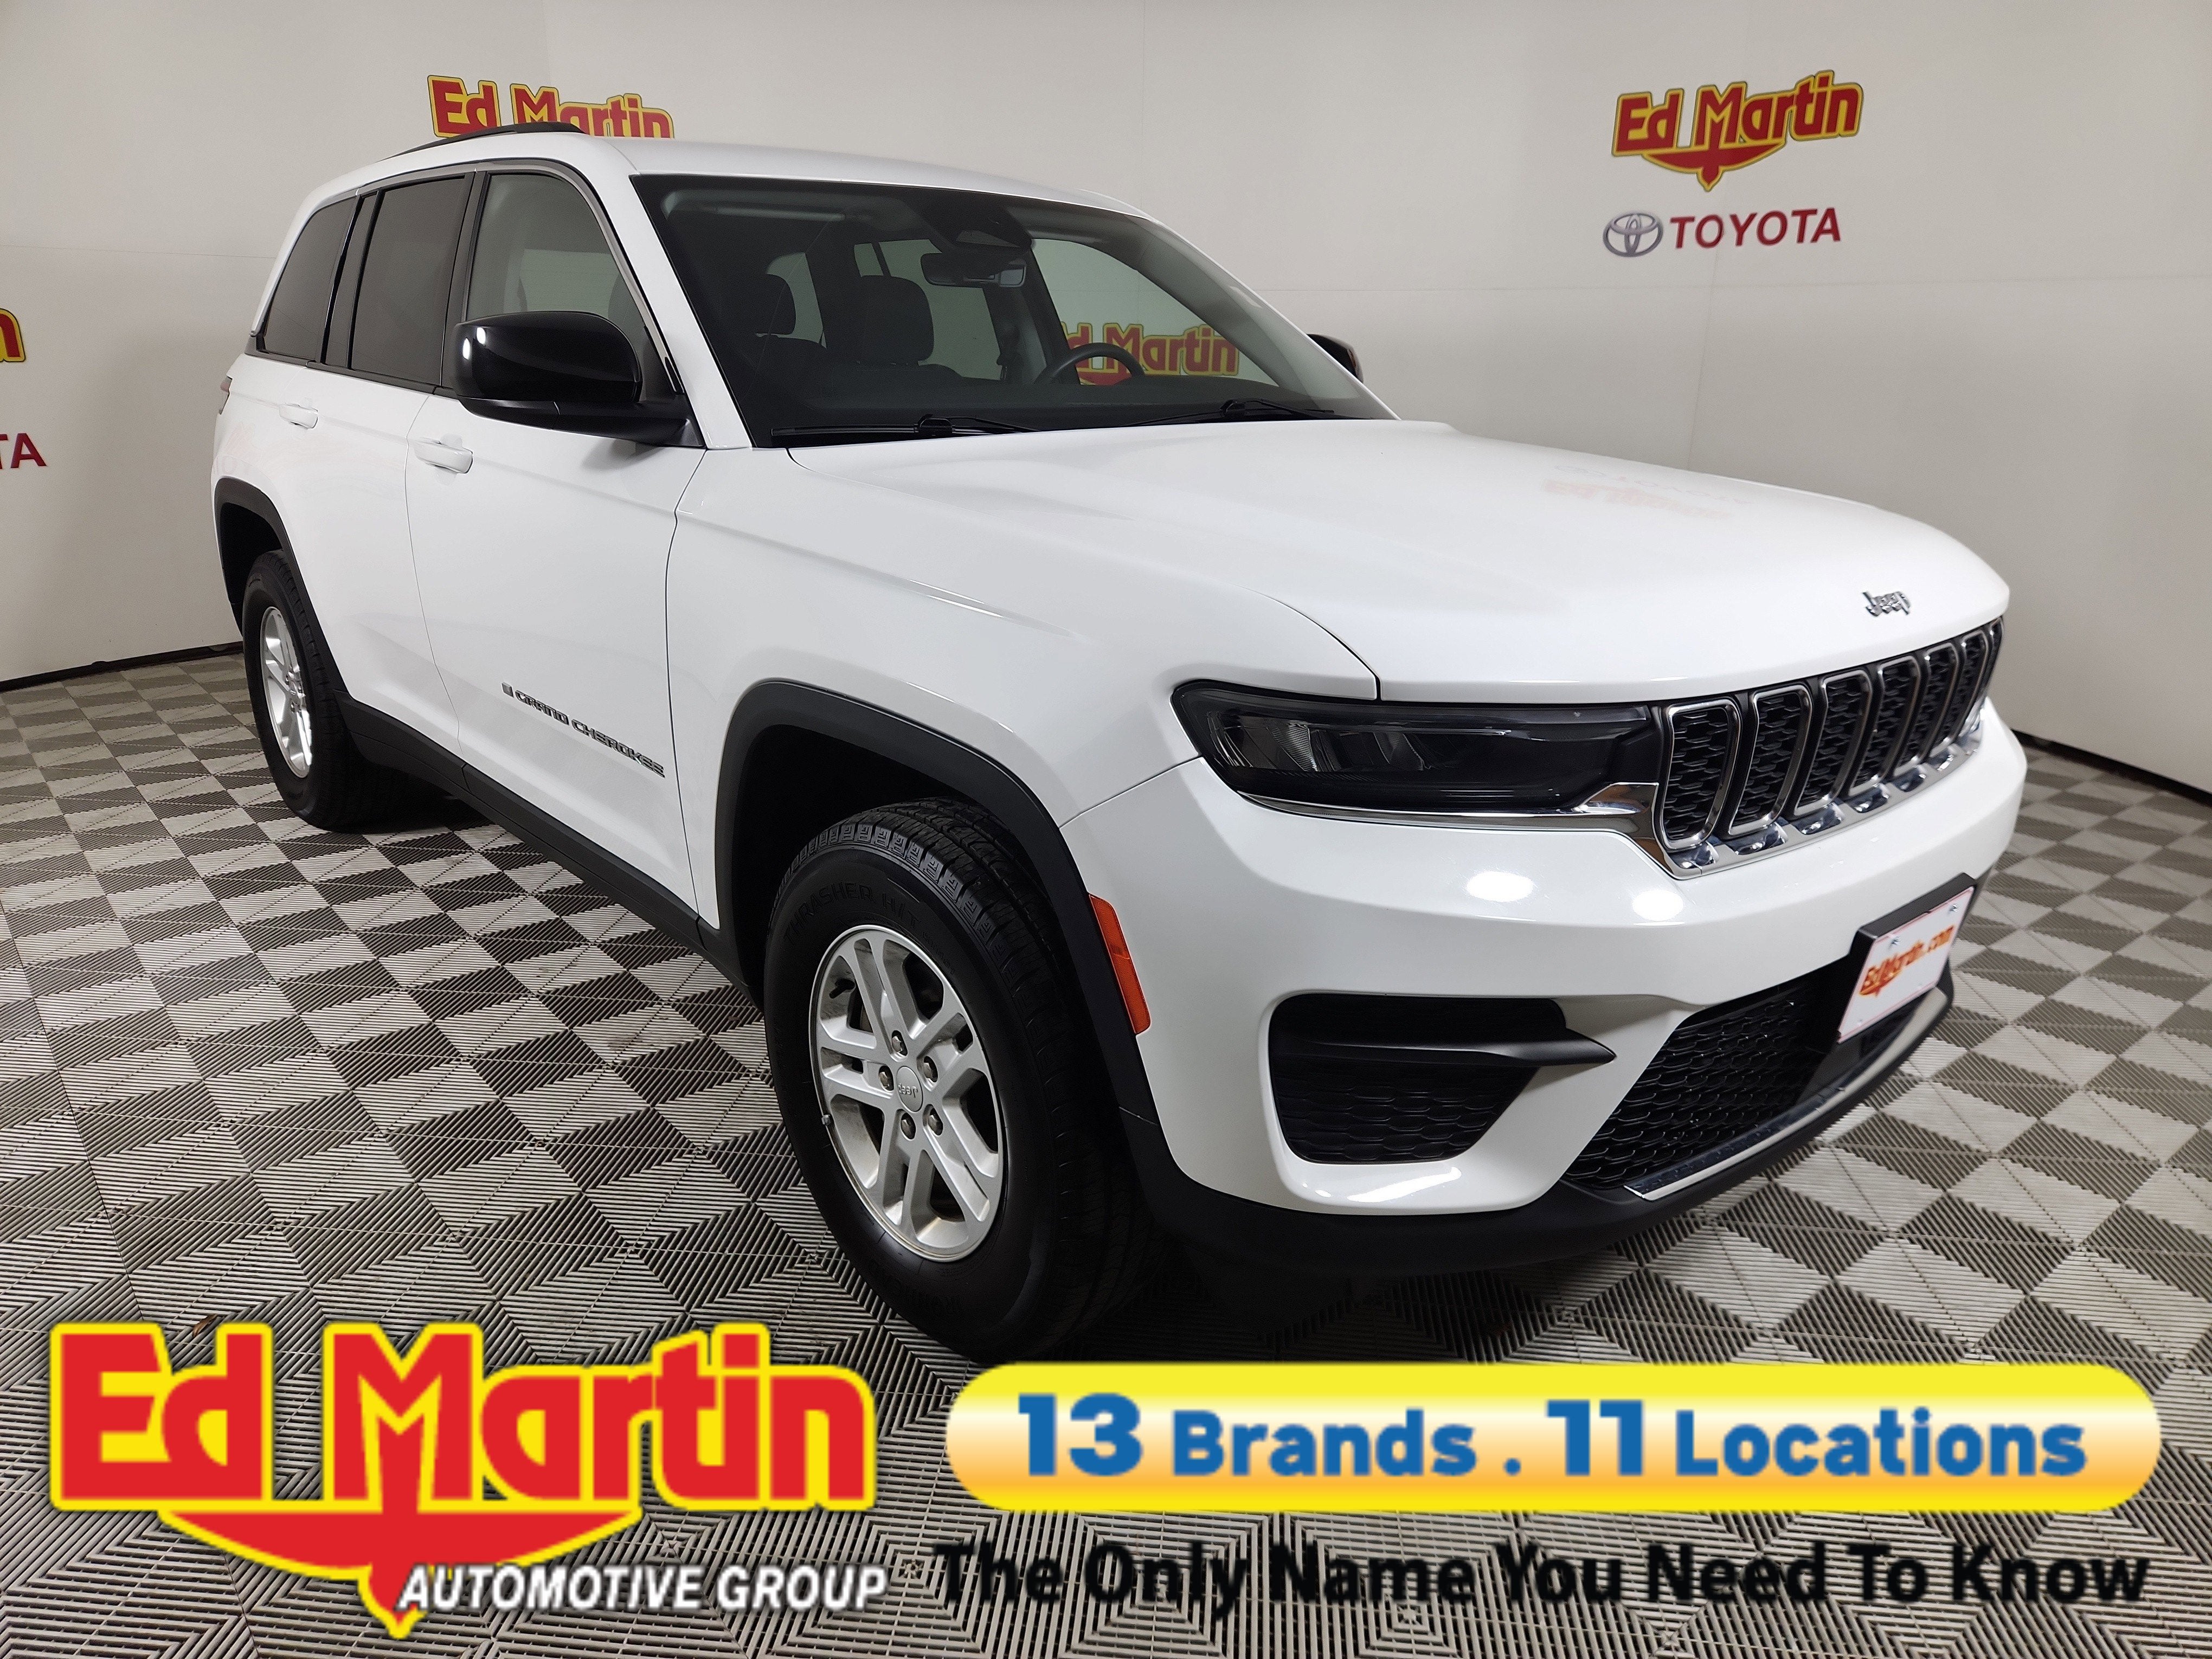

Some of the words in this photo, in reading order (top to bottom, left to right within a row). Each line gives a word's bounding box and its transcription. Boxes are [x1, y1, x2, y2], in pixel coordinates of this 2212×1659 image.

[430, 79, 501, 136] Ed
[512, 85, 671, 138] Martin
[1613, 92, 1681, 153] Ed
[1693, 74, 1862, 147] Martin
[1670, 207, 1841, 249] TOYOTA
[1105, 325, 1238, 373] Martin
[1862, 591, 1911, 617] Jeep
[515, 690, 569, 725] GRAND
[571, 719, 666, 779] CHEROKEE
[784, 881, 876, 946] THRASHER
